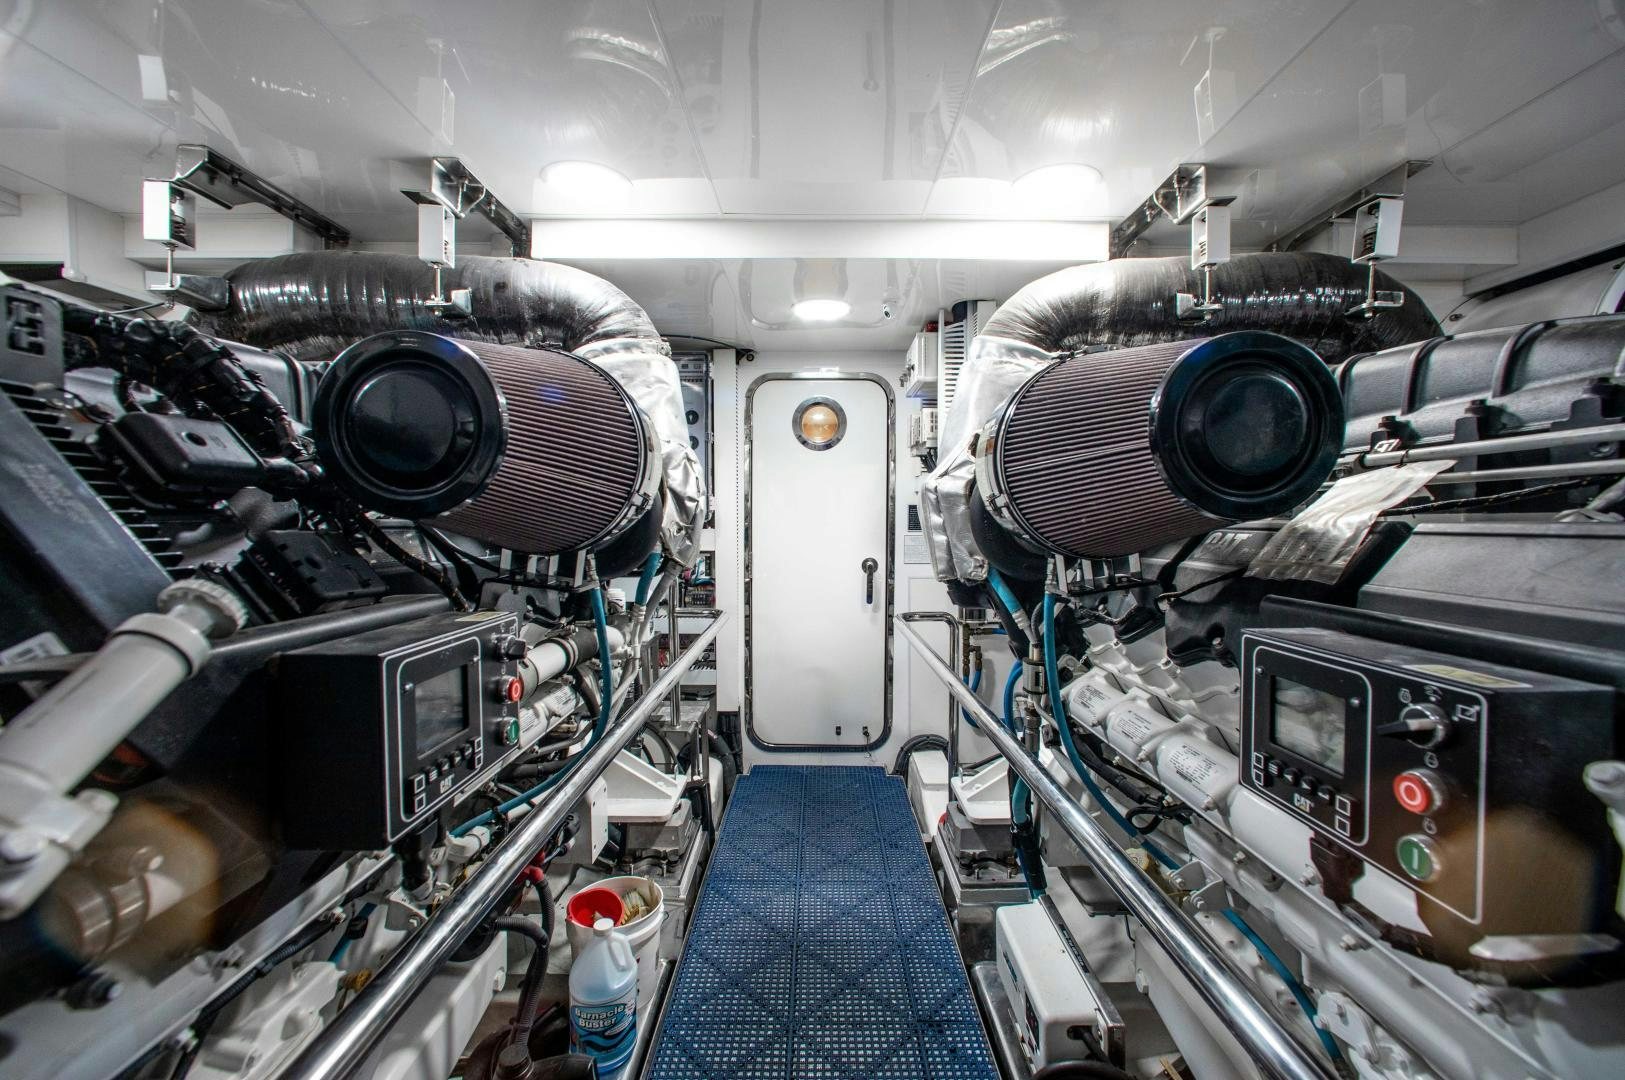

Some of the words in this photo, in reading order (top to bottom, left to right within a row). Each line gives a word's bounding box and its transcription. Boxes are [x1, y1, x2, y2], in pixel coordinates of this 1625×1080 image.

[440, 774, 454, 794] CAT
[1294, 792, 1313, 813] CAT
[578, 1017, 617, 1029] Buster
